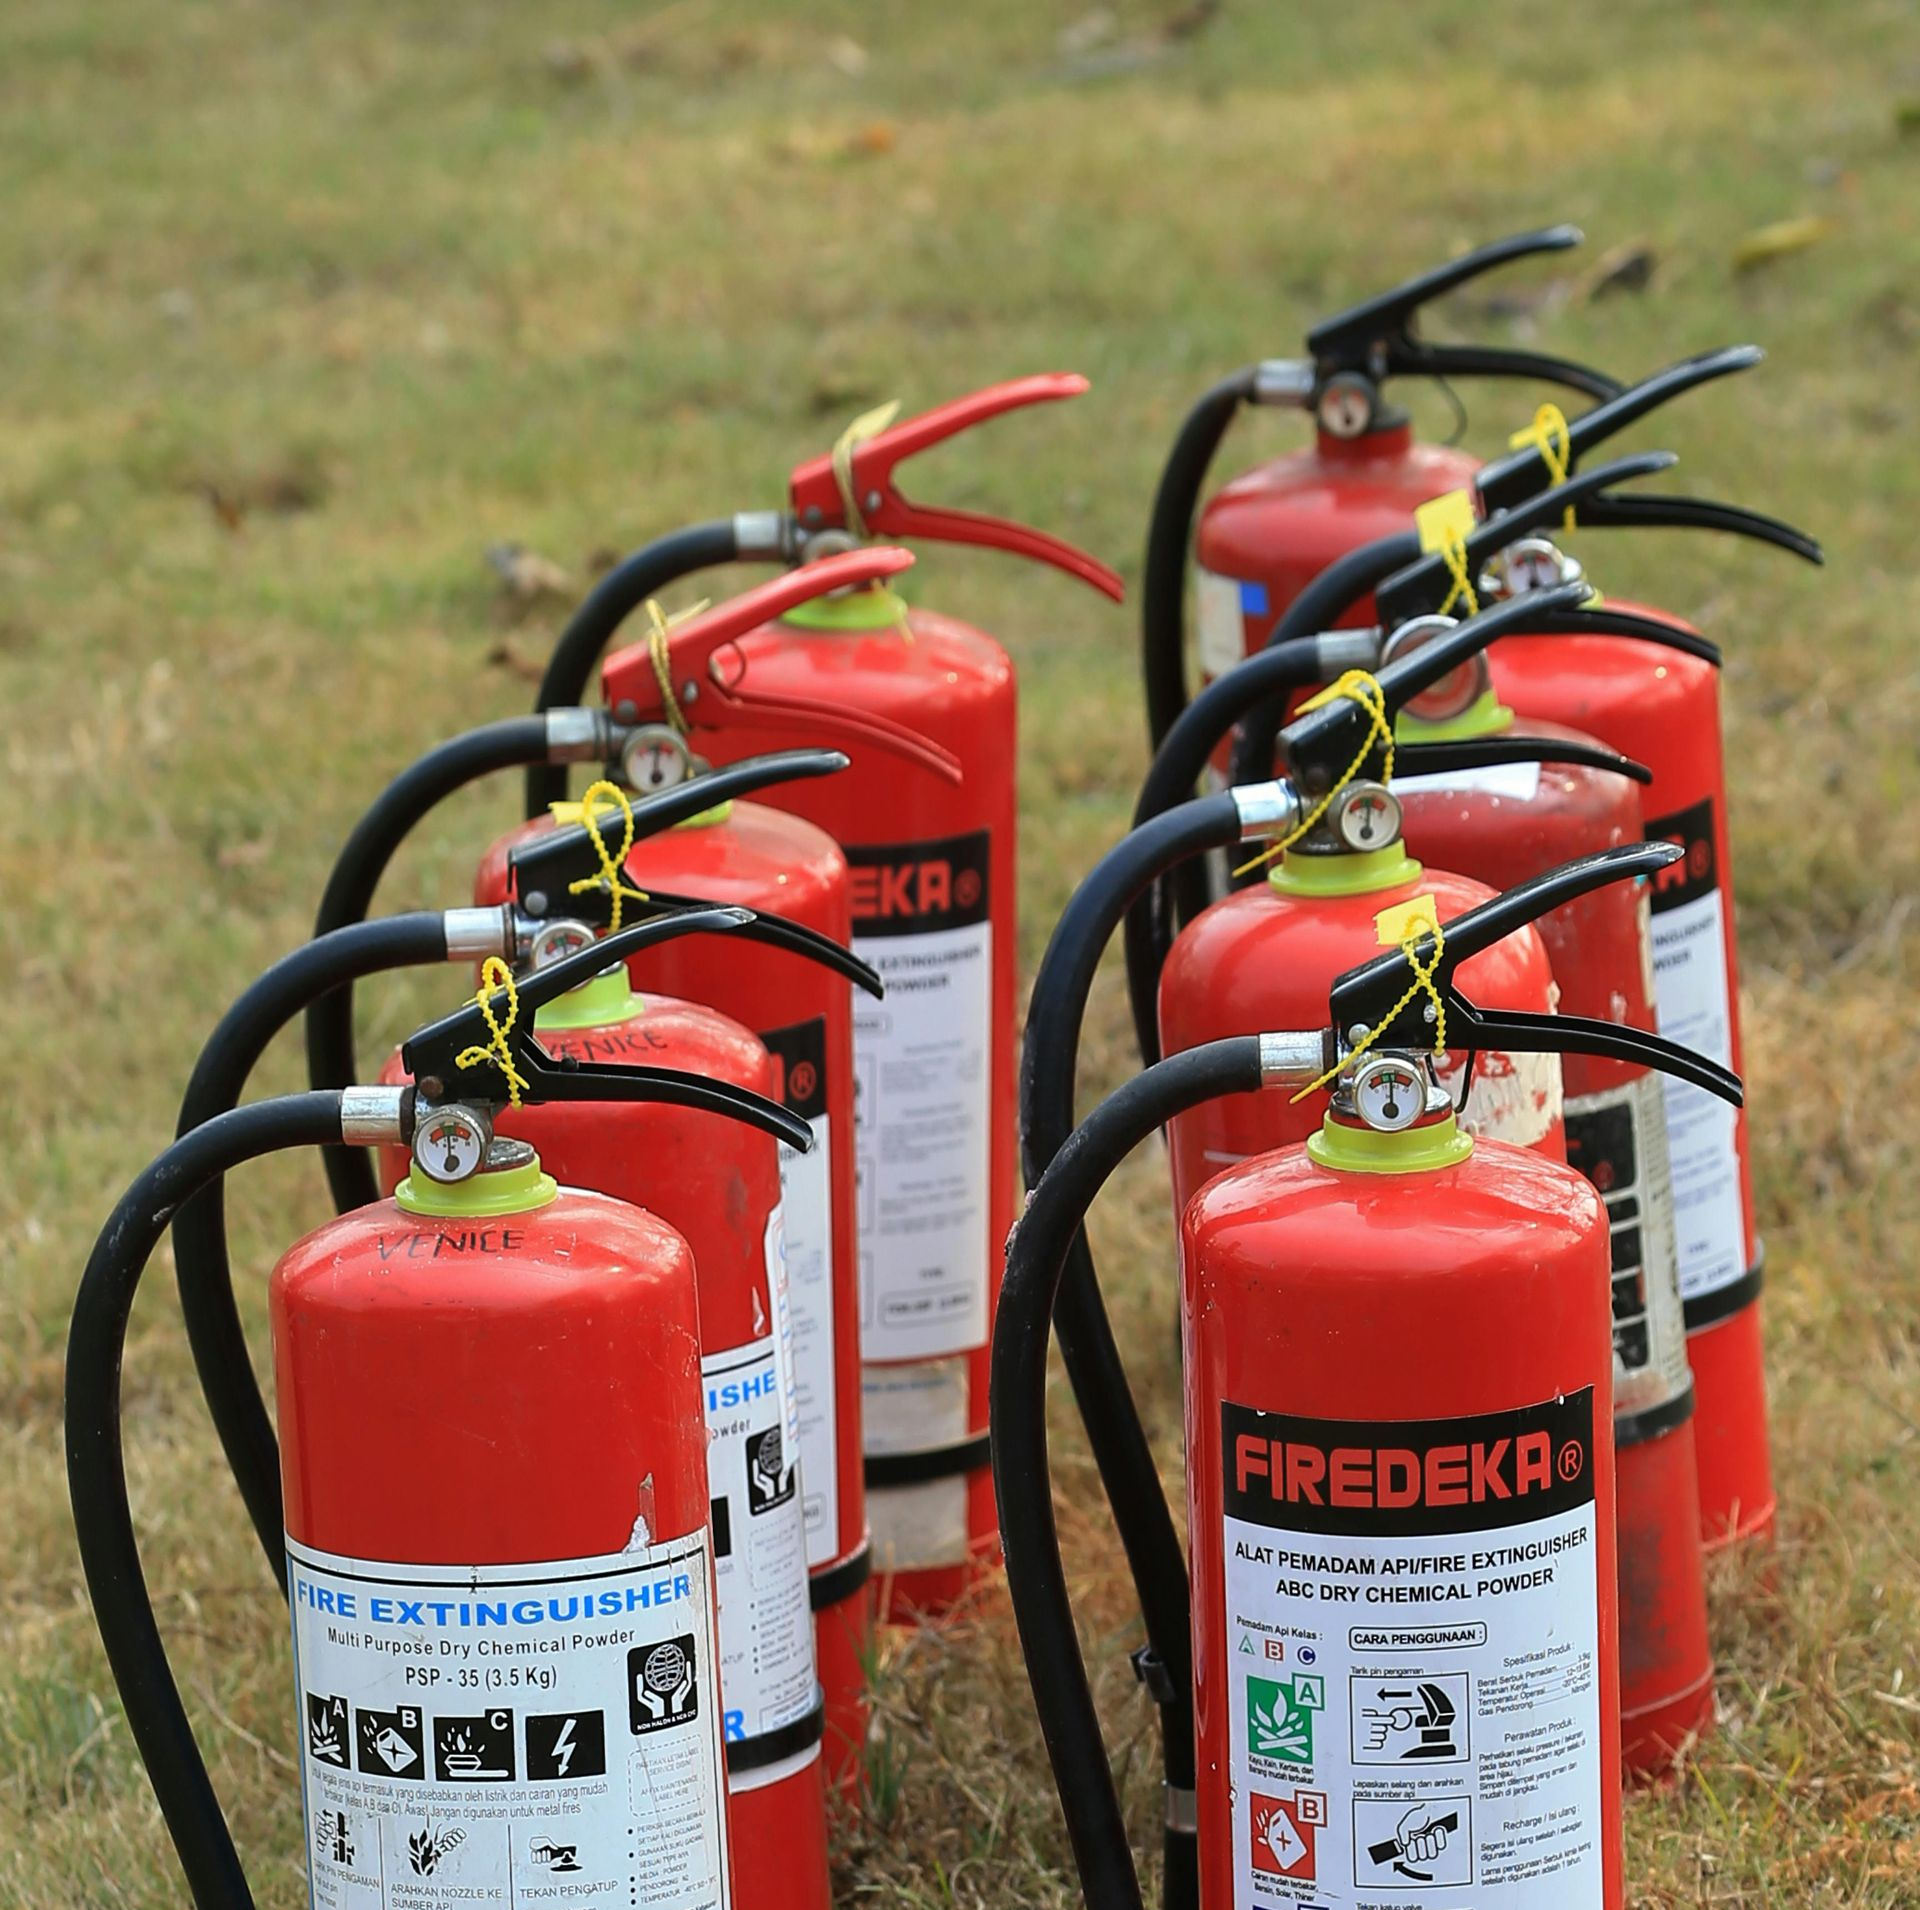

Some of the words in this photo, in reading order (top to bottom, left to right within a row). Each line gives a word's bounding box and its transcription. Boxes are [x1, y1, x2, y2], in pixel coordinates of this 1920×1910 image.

[377, 1230, 524, 1260] VENICE
[1236, 1431, 1551, 1508] FIREDEKA
[1235, 1542, 1274, 1565] ALAT
[1279, 1551, 1375, 1574] PEMADAM
[1380, 1554, 1466, 1576] API/FIRE
[1473, 1527, 1587, 1570] EXTINGUISHER
[1276, 1579, 1314, 1598] ABC
[1320, 1585, 1360, 1602] DRY
[1366, 1584, 1472, 1603] CHEMICAL
[1478, 1568, 1554, 1597] POWDER
[297, 1578, 356, 1619] FIRE
[370, 1574, 690, 1626] EXTINGUISHER
[1237, 1616, 1273, 1633] Pemadam
[1275, 1625, 1289, 1637] Api
[1292, 1628, 1317, 1640] Kelas
[1354, 1634, 1388, 1644] CARA
[1392, 1629, 1475, 1644] PENGGUNAAN
[328, 1627, 359, 1648] Multi
[365, 1635, 433, 1655] Purpose
[440, 1641, 470, 1659] Dry
[478, 1636, 566, 1656] Chemical
[572, 1630, 635, 1650] Powder
[1268, 1642, 1281, 1659] B
[1504, 1650, 1545, 1668] Spesifikasi
[1547, 1643, 1571, 1658] Produk
[406, 1667, 440, 1686] PSP
[458, 1669, 479, 1687] 35
[485, 1667, 519, 1692] (3.5
[526, 1665, 557, 1689] Kg)
[1351, 1666, 1368, 1674] Tarik
[1370, 1667, 1381, 1676] pin
[1384, 1668, 1424, 1677] pengaman
[1478, 1679, 1497, 1688] Berat
[1499, 1674, 1523, 1684] Serbuk
[1299, 1682, 1317, 1704] A
[1478, 1686, 1508, 1696] Tekanan
[333, 1699, 344, 1718] A
[1478, 1708, 1493, 1716] Gas
[1496, 1701, 1533, 1714] Pendorong
[1479, 1695, 1518, 1706] Temperatur
[402, 1710, 417, 1728] B
[491, 1712, 508, 1730] C
[1505, 1727, 1546, 1743] Perawatan
[1549, 1718, 1572, 1732] Produk
[1480, 1751, 1515, 1761] Perhatikan
[1480, 1763, 1496, 1773] pada
[1353, 1778, 1388, 1788] Lepaskan
[1391, 1781, 1415, 1789] selang
[1434, 1778, 1464, 1787] arahkan
[1480, 1780, 1506, 1790] Simpan
[362, 1783, 394, 1796] termasuk
[395, 1788, 414, 1803] yang
[416, 1788, 462, 1801] disebabkan
[465, 1790, 482, 1801] oleh
[511, 1789, 526, 1801] dan
[557, 1787, 578, 1800] yang
[580, 1783, 608, 1795] mudah
[1353, 1791, 1371, 1799] pada
[1480, 1791, 1504, 1800] mudah
[430, 1805, 460, 1819] Jangan
[464, 1807, 507, 1820] digunakan
[510, 1805, 534, 1817] untuk
[537, 1803, 560, 1816] metal
[563, 1803, 581, 1814] fires
[1303, 1798, 1318, 1819] B
[1503, 1816, 1542, 1831] Recharge
[1558, 1805, 1576, 1818] ulang
[1481, 1843, 1506, 1852] Segera
[338, 1869, 380, 1888] PENGAMAN
[1481, 1865, 1501, 1876] Lama
[391, 1884, 438, 1897] ARAHKAN
[441, 1889, 485, 1899] NOZZLE
[487, 1889, 502, 1898] KE
[520, 1889, 557, 1898] TEKAN
[560, 1881, 618, 1896] PENGATUP
[392, 1898, 433, 1910] SUMBER
